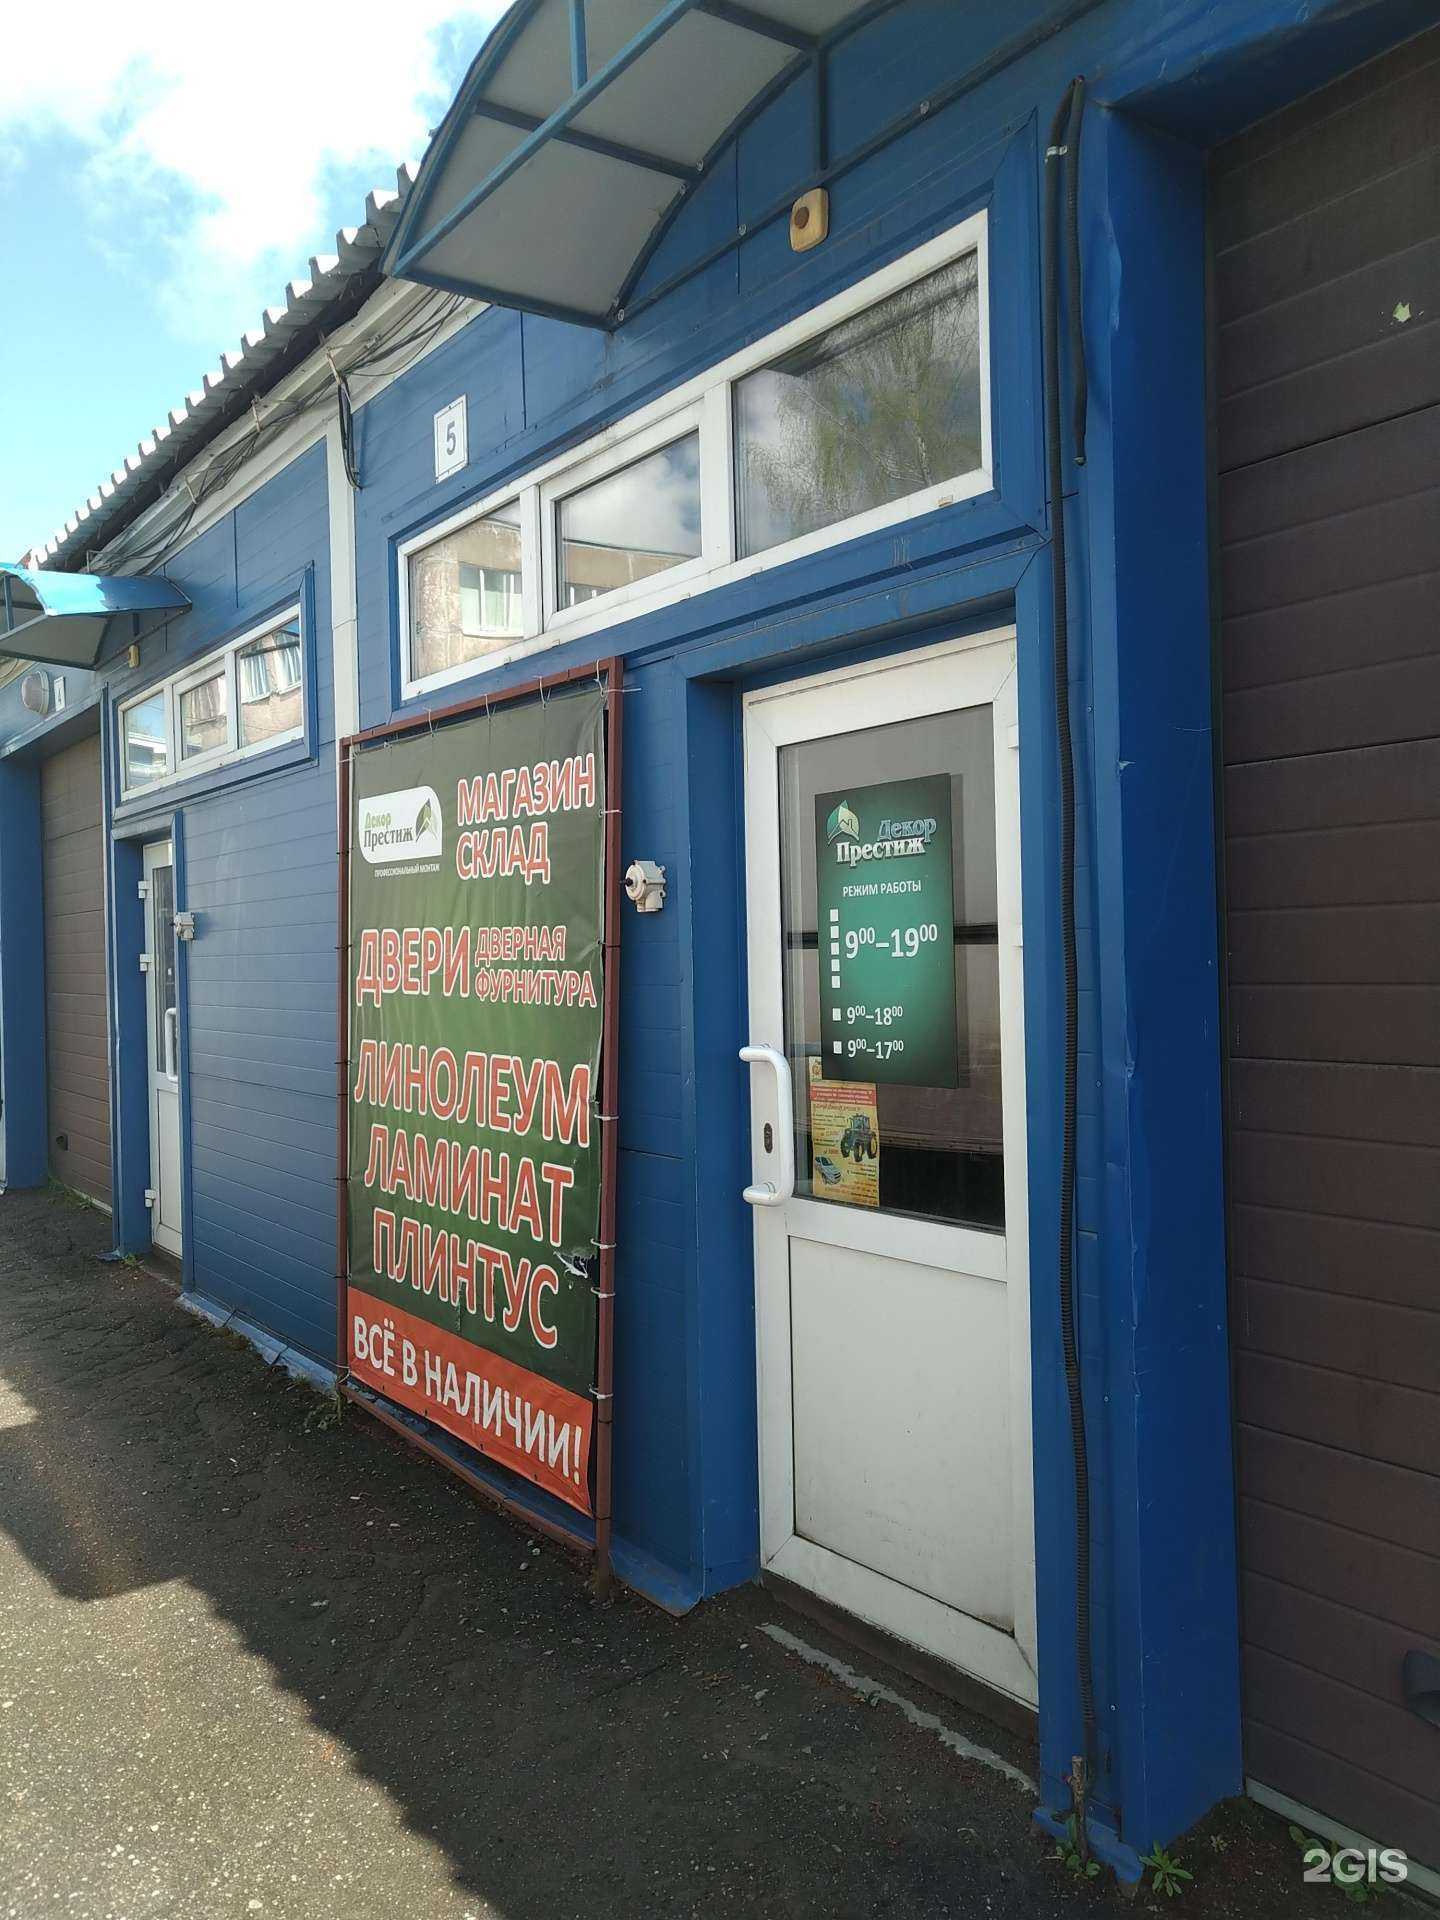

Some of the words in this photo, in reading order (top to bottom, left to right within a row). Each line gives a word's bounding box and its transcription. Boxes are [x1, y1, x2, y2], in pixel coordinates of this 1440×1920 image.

[446, 421, 456, 456] 5
[457, 752, 595, 826] МАГАЗИН
[364, 812, 391, 830] Декор
[364, 827, 413, 852] Престиж
[877, 816, 937, 843] Декор
[456, 821, 551, 885] СКЛАД
[836, 837, 927, 867] Престиж
[842, 884, 878, 897] РЕЖИМ
[880, 880, 921, 895] РАБОТЫ
[356, 926, 471, 1008] ДВЕРИ
[475, 925, 567, 967] ДВЕРНАЯ
[474, 968, 598, 1008] ФУРНИТУРА
[354, 1039, 591, 1148] ЛИНОЛЕУМ
[364, 1123, 574, 1247] ЛАМИНАТ
[373, 1207, 559, 1349] ПЛИНТУС
[353, 1315, 395, 1377] ВСЁ
[402, 1339, 418, 1386] В
[424, 1349, 582, 1484] НАЛИЧИИ!
